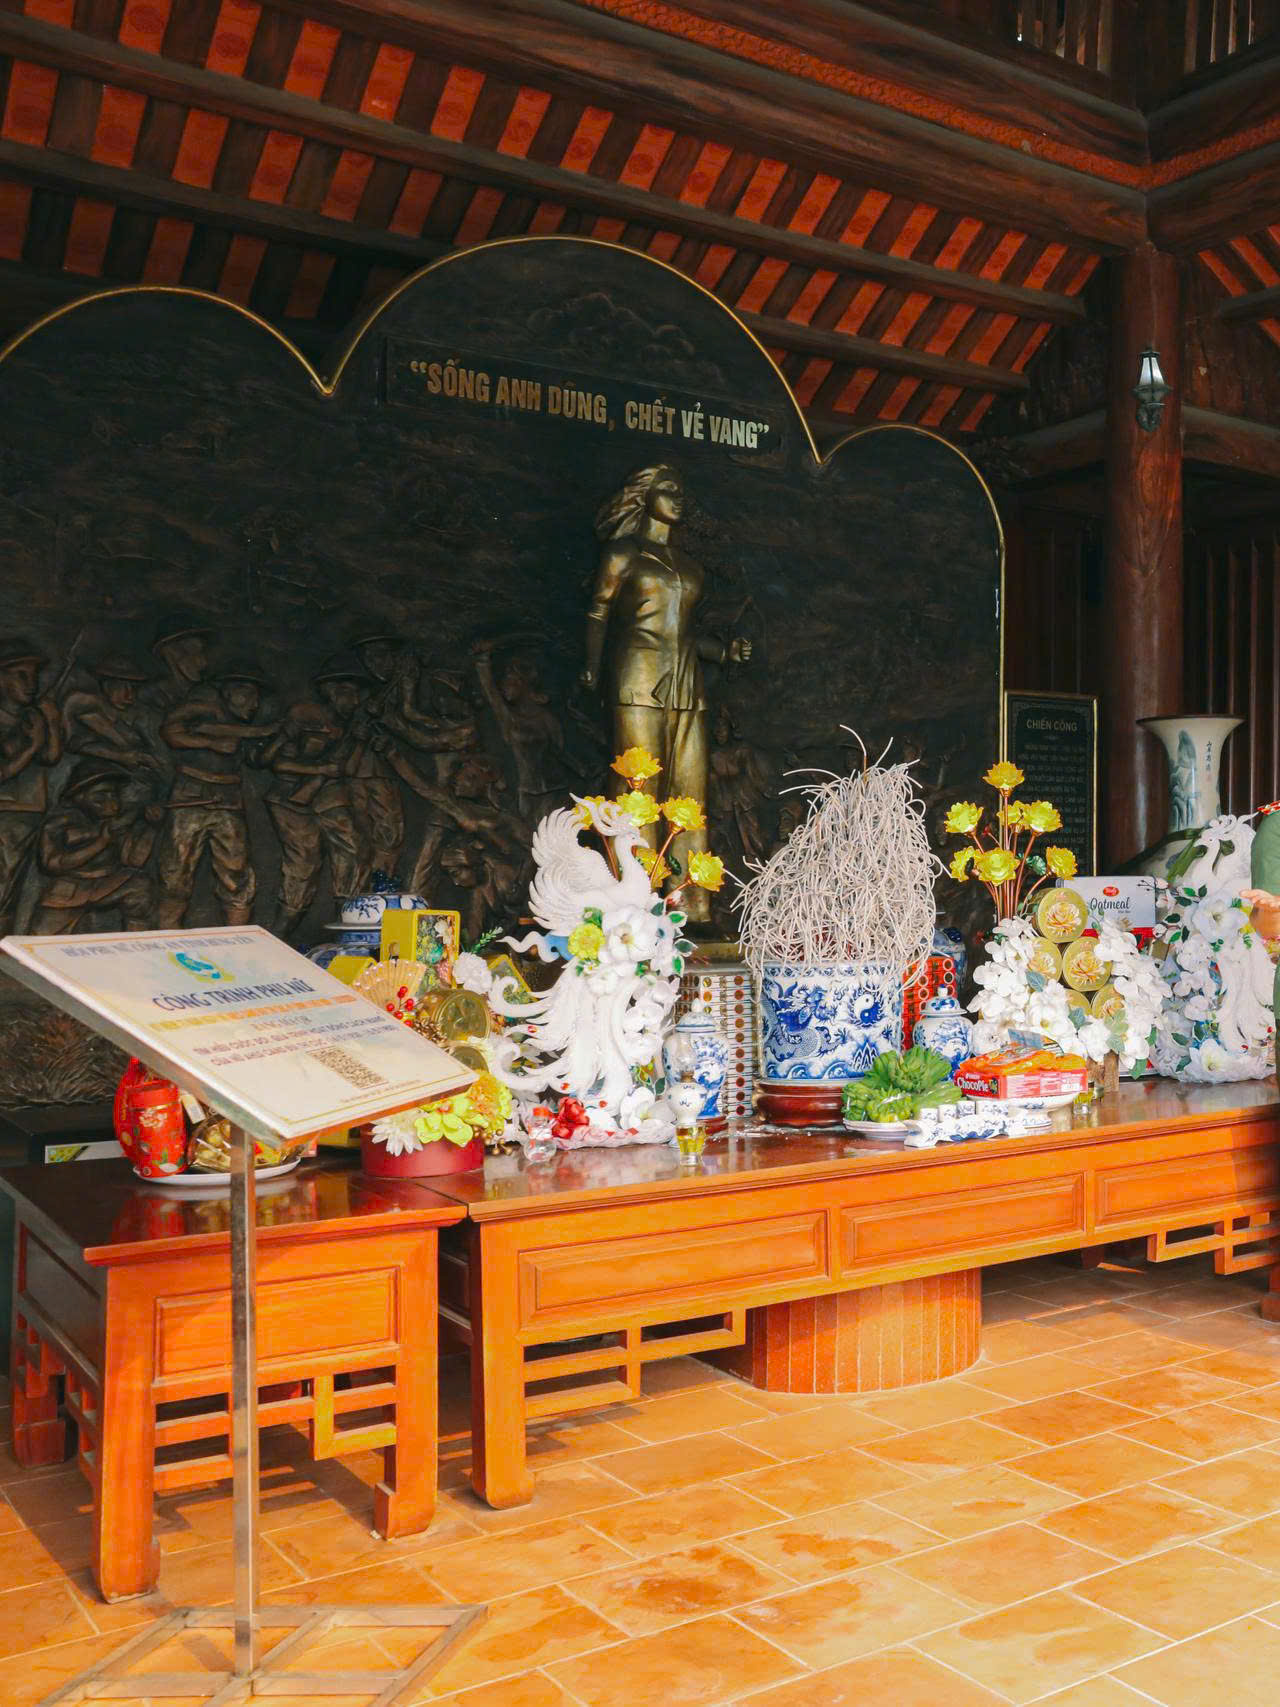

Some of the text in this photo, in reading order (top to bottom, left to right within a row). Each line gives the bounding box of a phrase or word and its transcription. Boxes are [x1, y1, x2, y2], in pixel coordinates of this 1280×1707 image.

[496, 376, 542, 411] ANH
[548, 381, 616, 432] DŨNG,
[625, 393, 676, 435] CHẾT
[681, 401, 704, 440] VẺ
[709, 415, 769, 449] VANG”
[1090, 897, 1130, 910] Oatmeal
[152, 992, 212, 1012] CÔNG
